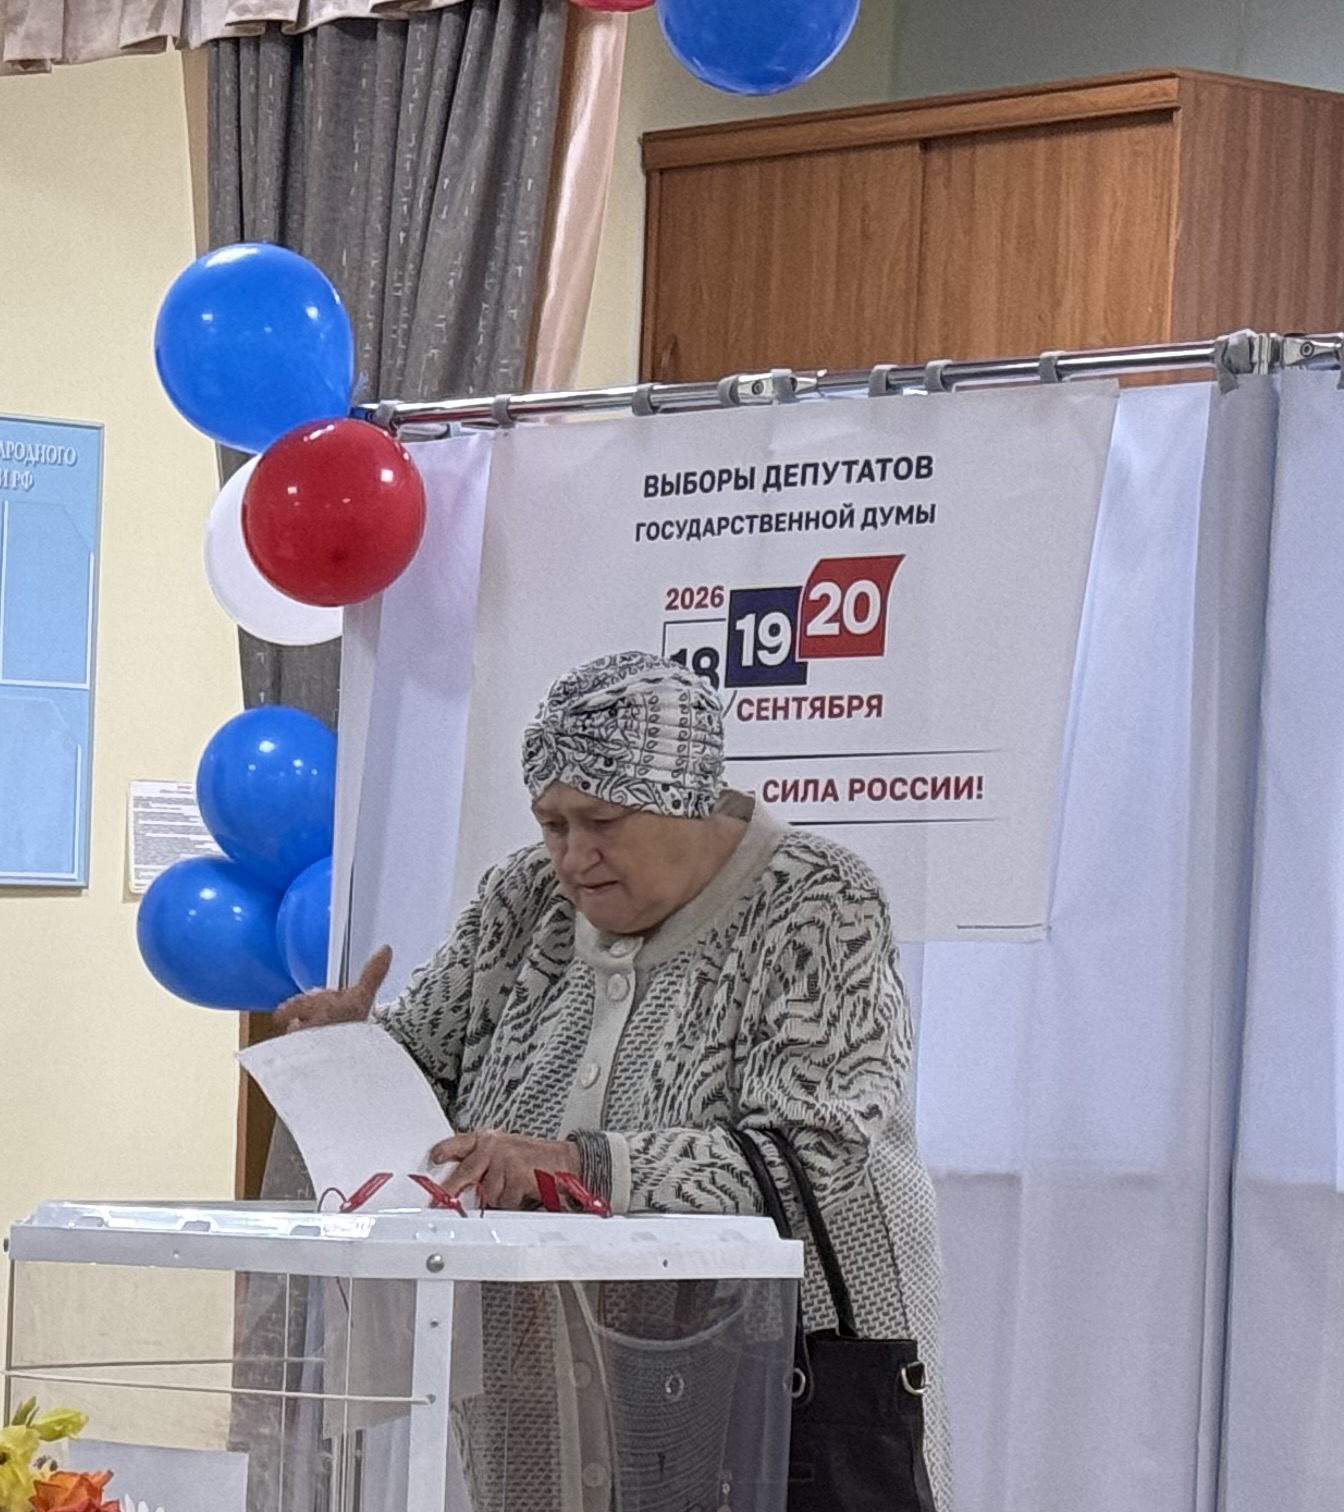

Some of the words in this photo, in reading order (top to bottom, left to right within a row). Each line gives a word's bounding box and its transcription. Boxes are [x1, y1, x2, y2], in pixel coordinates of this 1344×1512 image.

[10, 470, 35, 491] РФ
[643, 466, 756, 498] ВЫБОРЫ
[762, 455, 934, 493] ДЕПУТАТОВ
[635, 502, 855, 542] ГОСУДАРСТВЕННОЙ
[860, 503, 937, 531] ДУМЫ
[665, 585, 725, 611] 2026
[735, 611, 792, 667] 19
[806, 579, 882, 636] 20
[736, 694, 884, 722] СЕНТЯБРЯ
[762, 778, 839, 804] СИЛА
[848, 775, 985, 803] РОССИИ!
